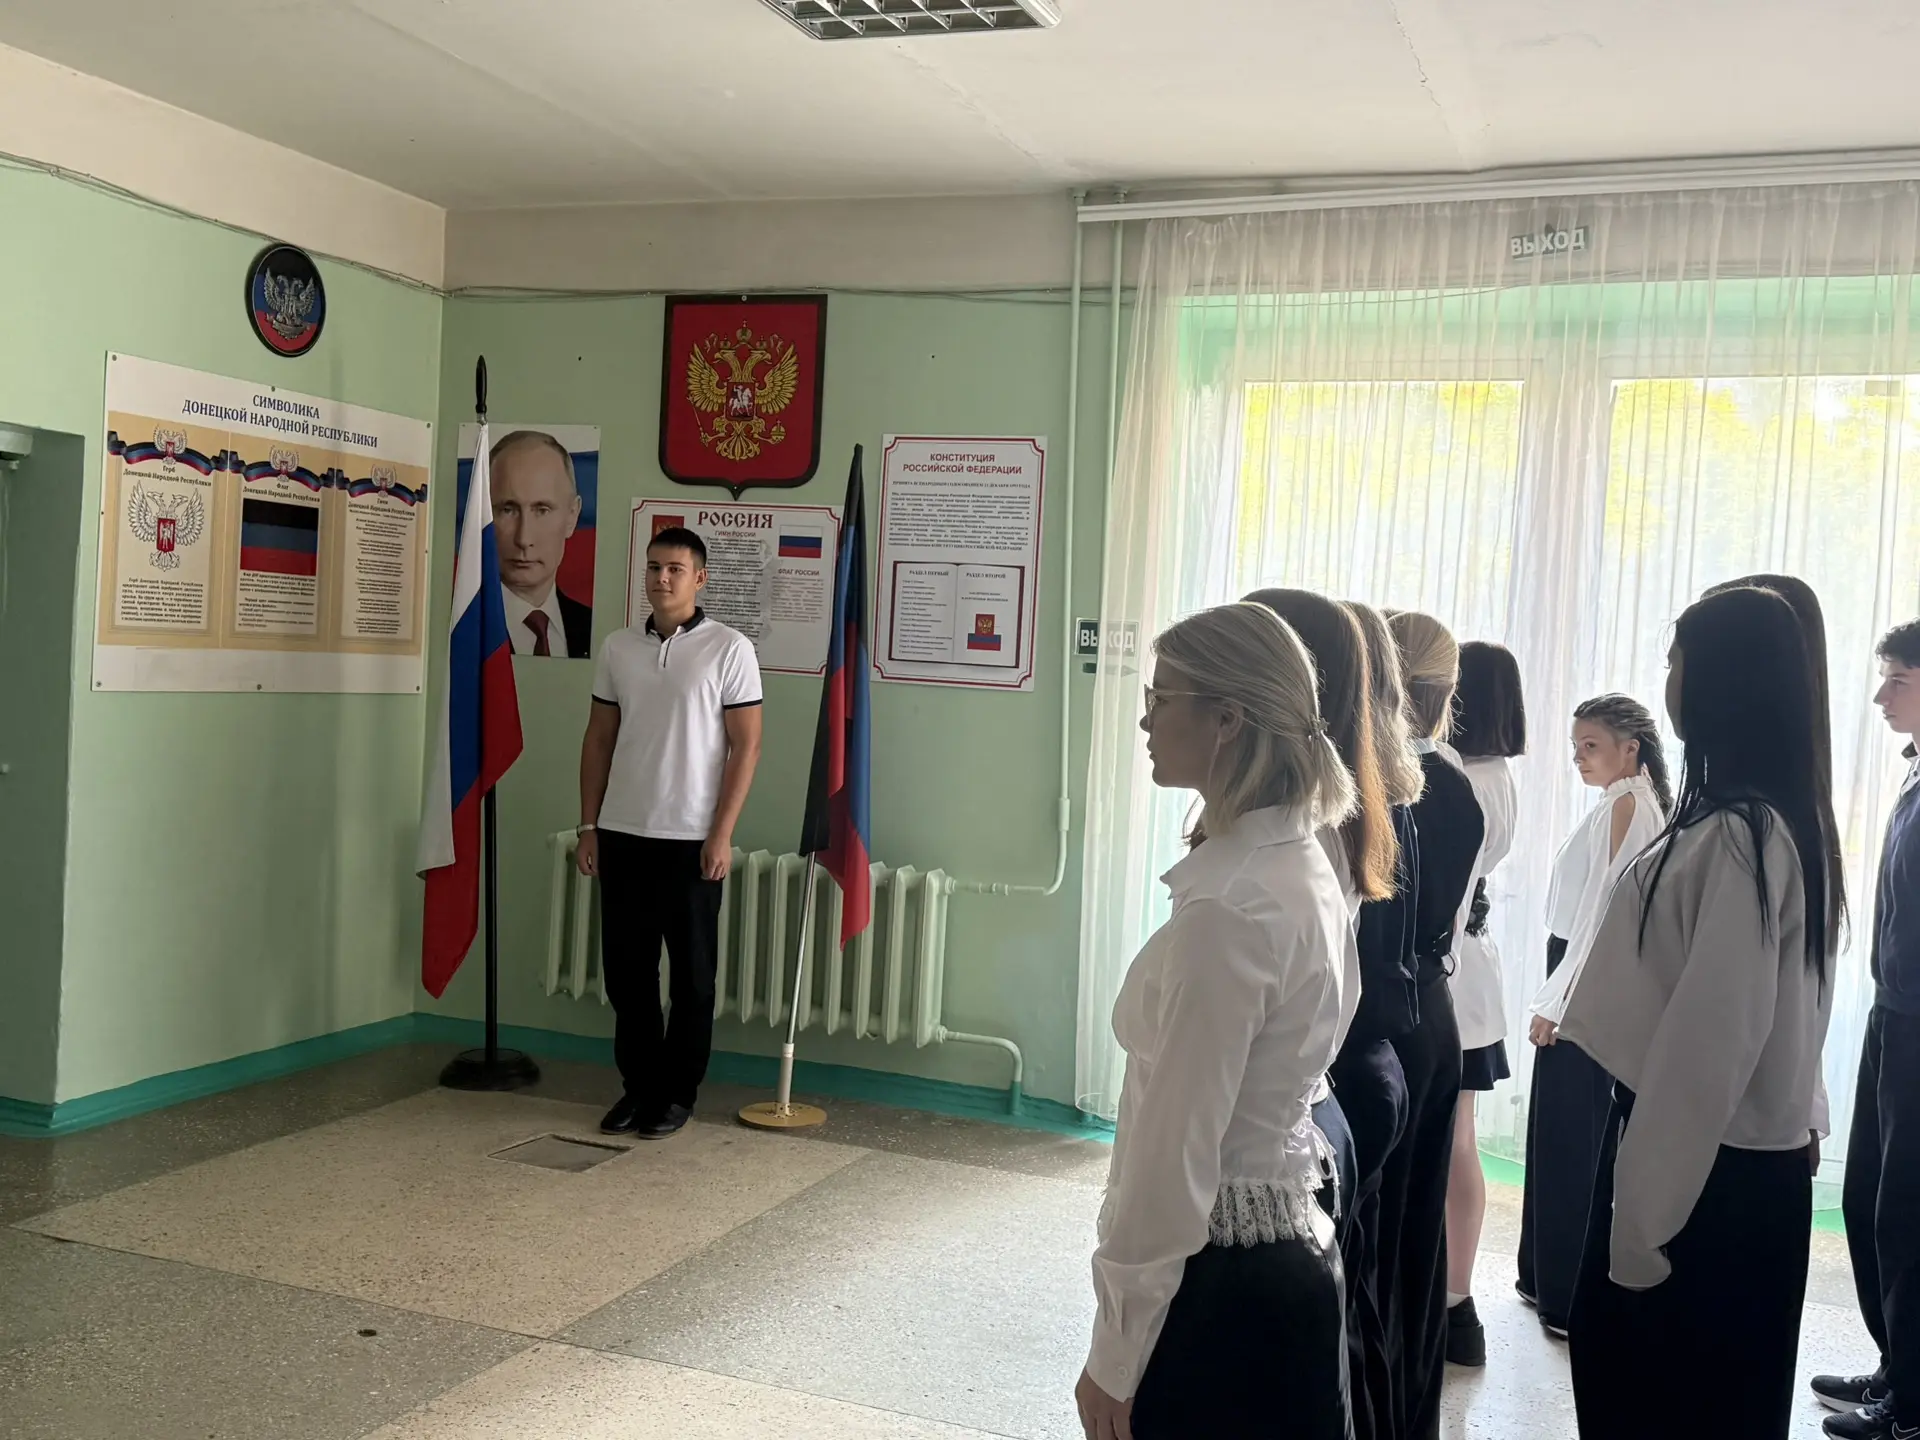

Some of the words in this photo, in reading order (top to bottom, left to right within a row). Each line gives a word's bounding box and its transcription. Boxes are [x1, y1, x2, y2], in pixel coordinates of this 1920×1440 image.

[1511, 228, 1585, 257] ВЫХОД
[252, 394, 320, 419] СИМВОЛИКА
[182, 399, 248, 423] ДОНЕЦКОЙ
[250, 412, 309, 435] НАРОДНОЙ
[312, 425, 378, 448] РЕСПУБЛИКИ
[903, 462, 964, 474] РОССИЙСКОЙ
[966, 464, 1022, 475] ФЕДЕРАЦИИ
[930, 453, 995, 463] КОНСТИТУЦИЯ
[697, 511, 774, 528] РОССИЯ
